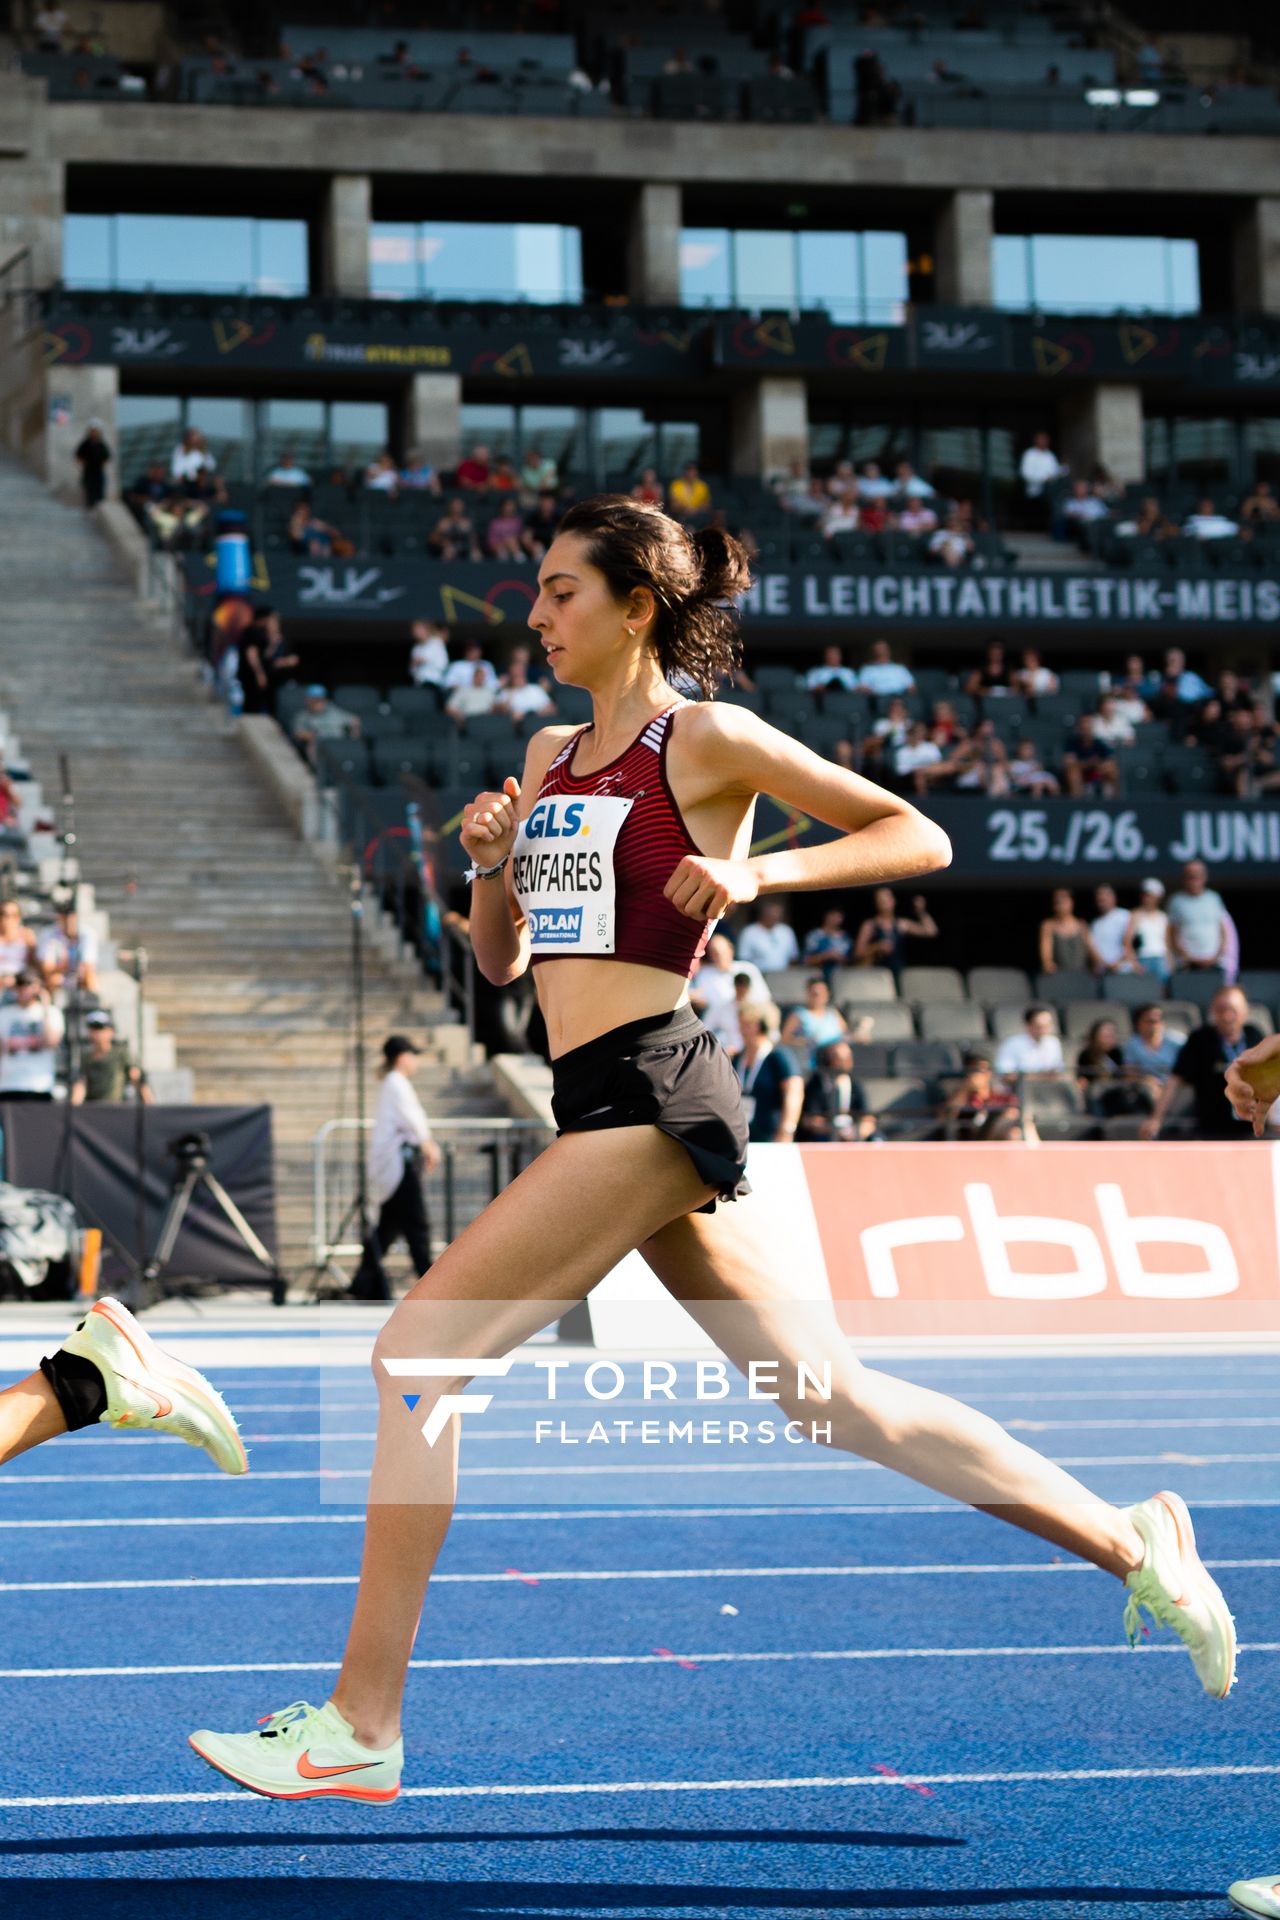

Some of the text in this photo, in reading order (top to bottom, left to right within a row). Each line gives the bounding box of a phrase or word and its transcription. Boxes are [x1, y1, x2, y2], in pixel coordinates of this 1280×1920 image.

[988, 810, 1280, 865] 25./26. JUNI
[513, 851, 603, 895] BENFARES
[539, 914, 580, 931] PLAN
[596, 913, 608, 937] 526
[860, 1183, 1240, 1300] rbb
